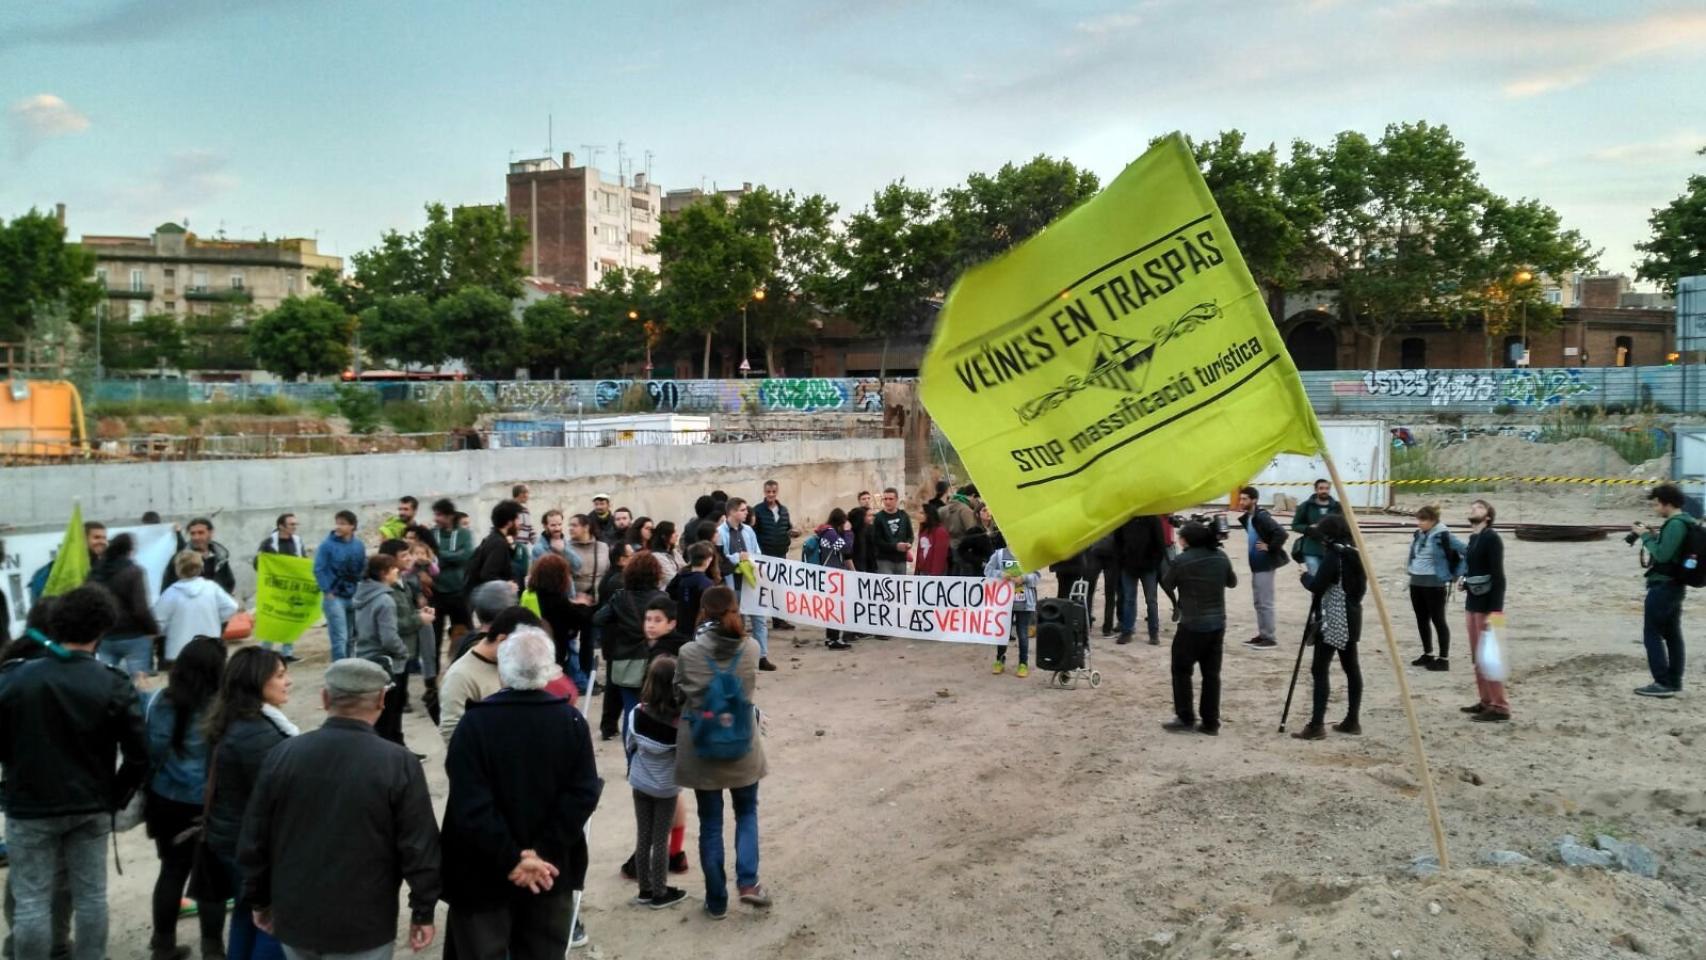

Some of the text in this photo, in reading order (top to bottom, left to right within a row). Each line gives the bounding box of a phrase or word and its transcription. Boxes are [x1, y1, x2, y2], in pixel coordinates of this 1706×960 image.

[955, 230, 1224, 393] VEÏNES EN TRASPÀS
[1011, 336, 1263, 472] STOP massificació turística
[755, 560, 844, 597] TURISME SI
[984, 577, 1012, 607] NO
[758, 586, 845, 624] EL BARRI
[854, 602, 892, 627] PER
[934, 608, 1009, 637] VEÏNES
